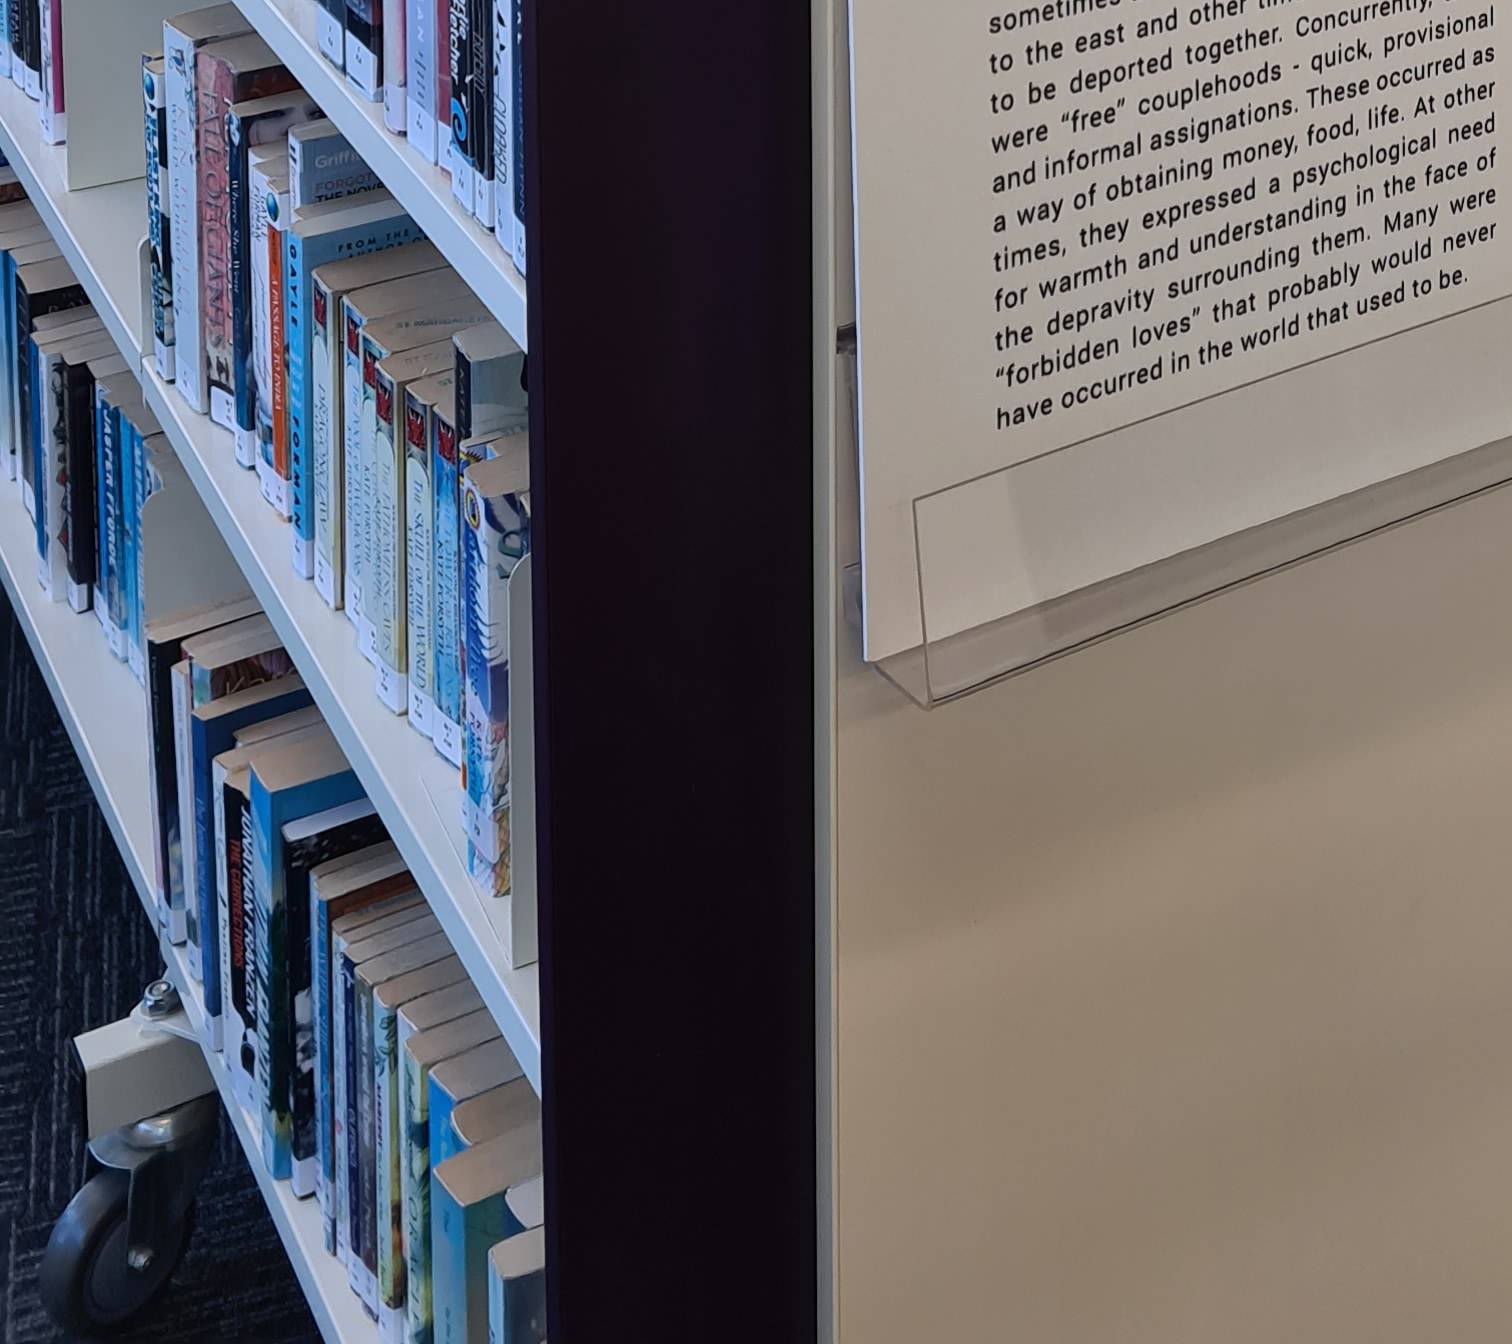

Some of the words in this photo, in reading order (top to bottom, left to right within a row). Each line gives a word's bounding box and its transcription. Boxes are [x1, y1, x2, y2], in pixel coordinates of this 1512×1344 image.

[992, 213, 1007, 234] a
[1015, 196, 1064, 227] way
[1072, 181, 1097, 211] of
[1104, 156, 1213, 202] obtaining
[1221, 133, 1298, 170] money,
[1305, 111, 1360, 147] food,
[1367, 102, 1405, 131] life.
[1412, 94, 1436, 119] At
[1442, 79, 1496, 110] other
[289, 243, 300, 329] GAYLE
[338, 236, 377, 252] FROM
[386, 228, 410, 242] THE
[995, 396, 1053, 431] have
[1060, 354, 1163, 409] occurred
[1170, 350, 1190, 375] in
[1196, 339, 1233, 366] the
[1239, 311, 1300, 352] world
[1305, 300, 1349, 331] that
[1355, 279, 1405, 316] used
[1411, 277, 1432, 299] to
[1438, 267, 1468, 290] be.
[291, 408, 305, 532] FORMAN
[241, 804, 254, 913] JONATHAN
[244, 915, 257, 1019] FRANZEN
